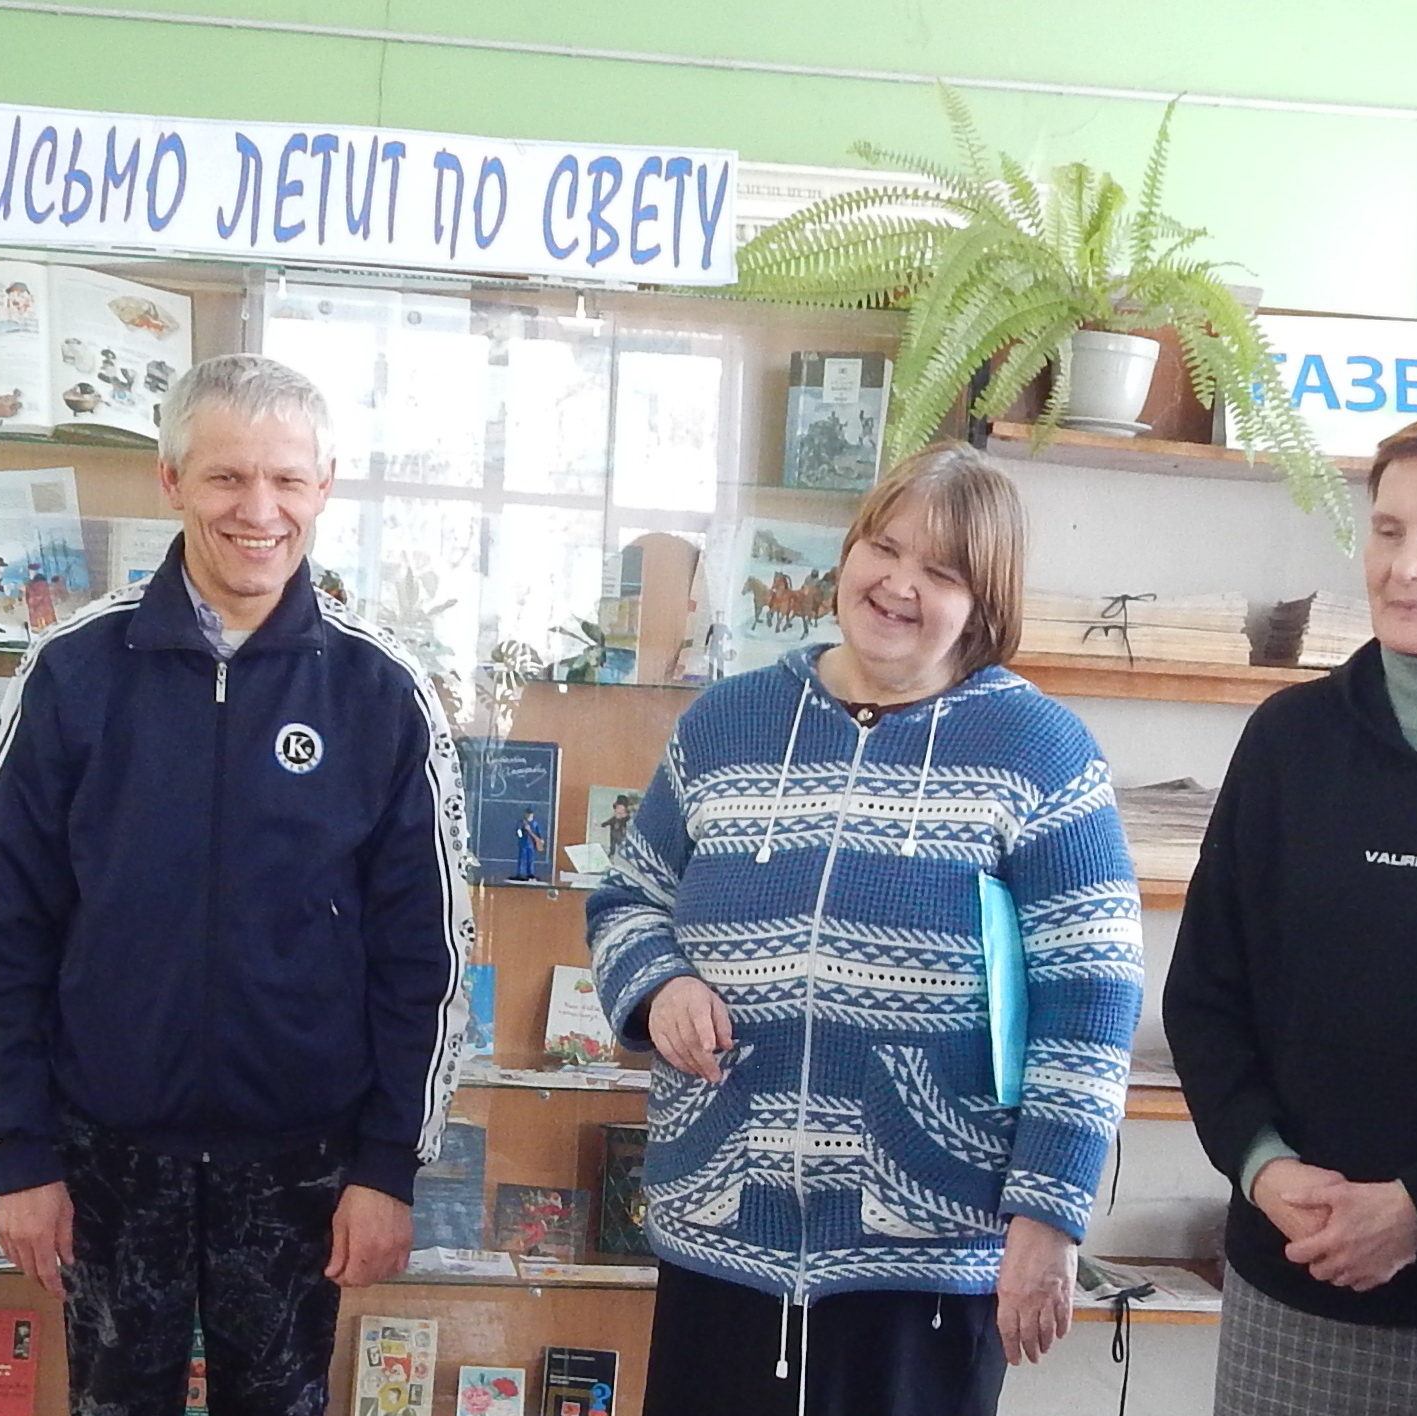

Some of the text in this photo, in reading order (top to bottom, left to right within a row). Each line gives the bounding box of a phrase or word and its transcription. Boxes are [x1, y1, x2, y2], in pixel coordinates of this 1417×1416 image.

[216, 131, 405, 249] ЛЕТИТ
[433, 147, 508, 260] ПО
[542, 154, 730, 270] СВЕТУ
